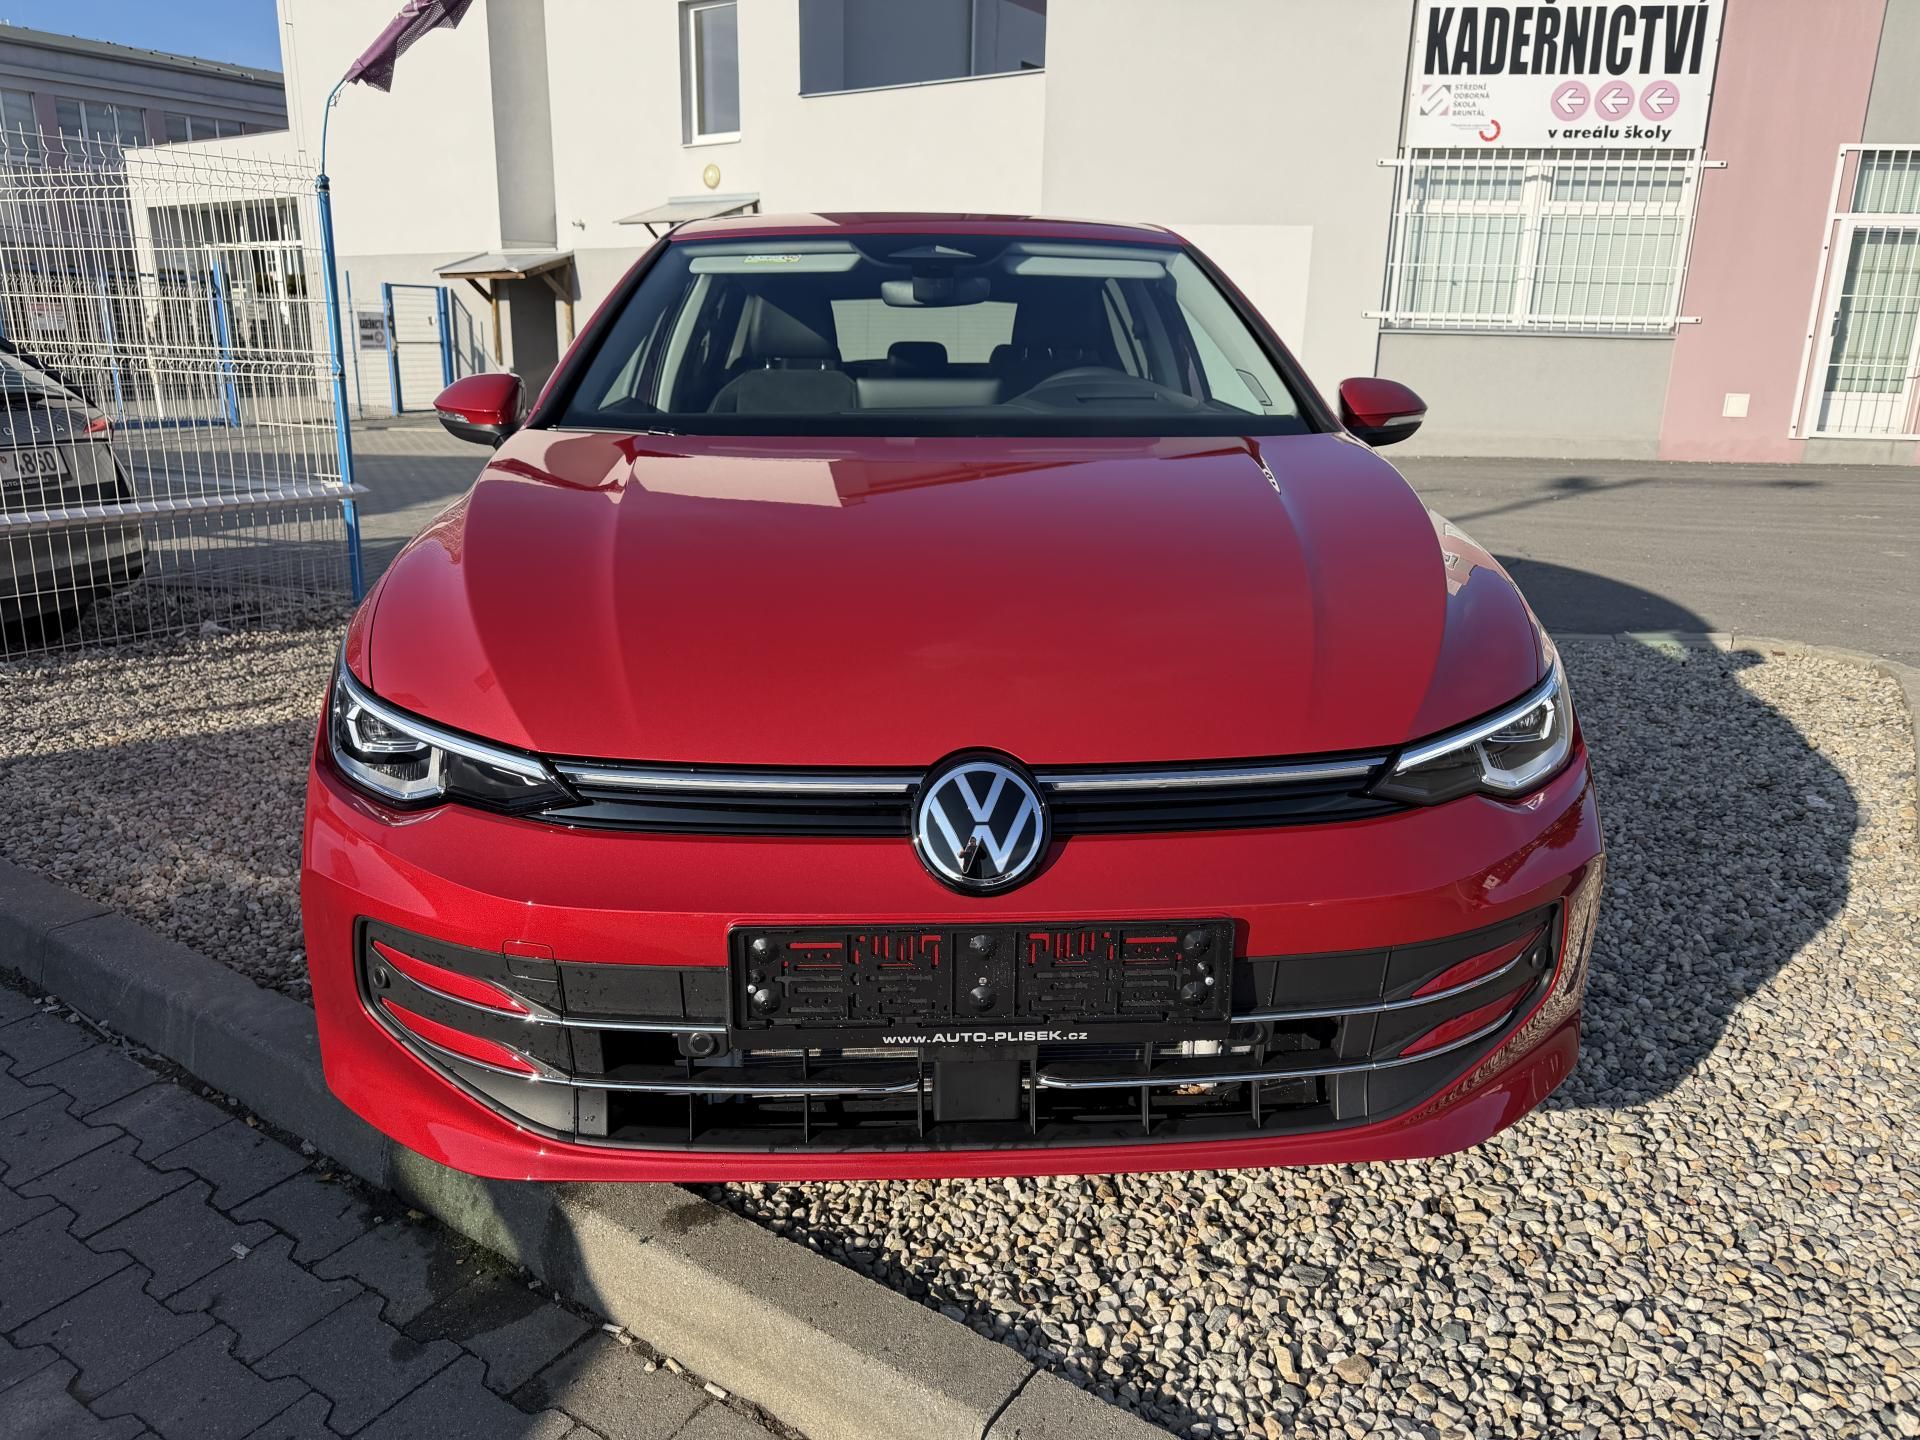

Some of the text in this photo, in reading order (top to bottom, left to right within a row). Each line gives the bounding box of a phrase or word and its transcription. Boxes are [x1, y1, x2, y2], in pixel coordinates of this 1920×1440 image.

[1424, 0, 1709, 75] KADEŘNICTVÍ
[1455, 82, 1487, 91] STŘEDNÍ
[1453, 100, 1477, 108] ŠKOLA
[1548, 125, 1672, 142] v areálu školy
[882, 1030, 1088, 1044] www.AUTO-PLISEK.cz
